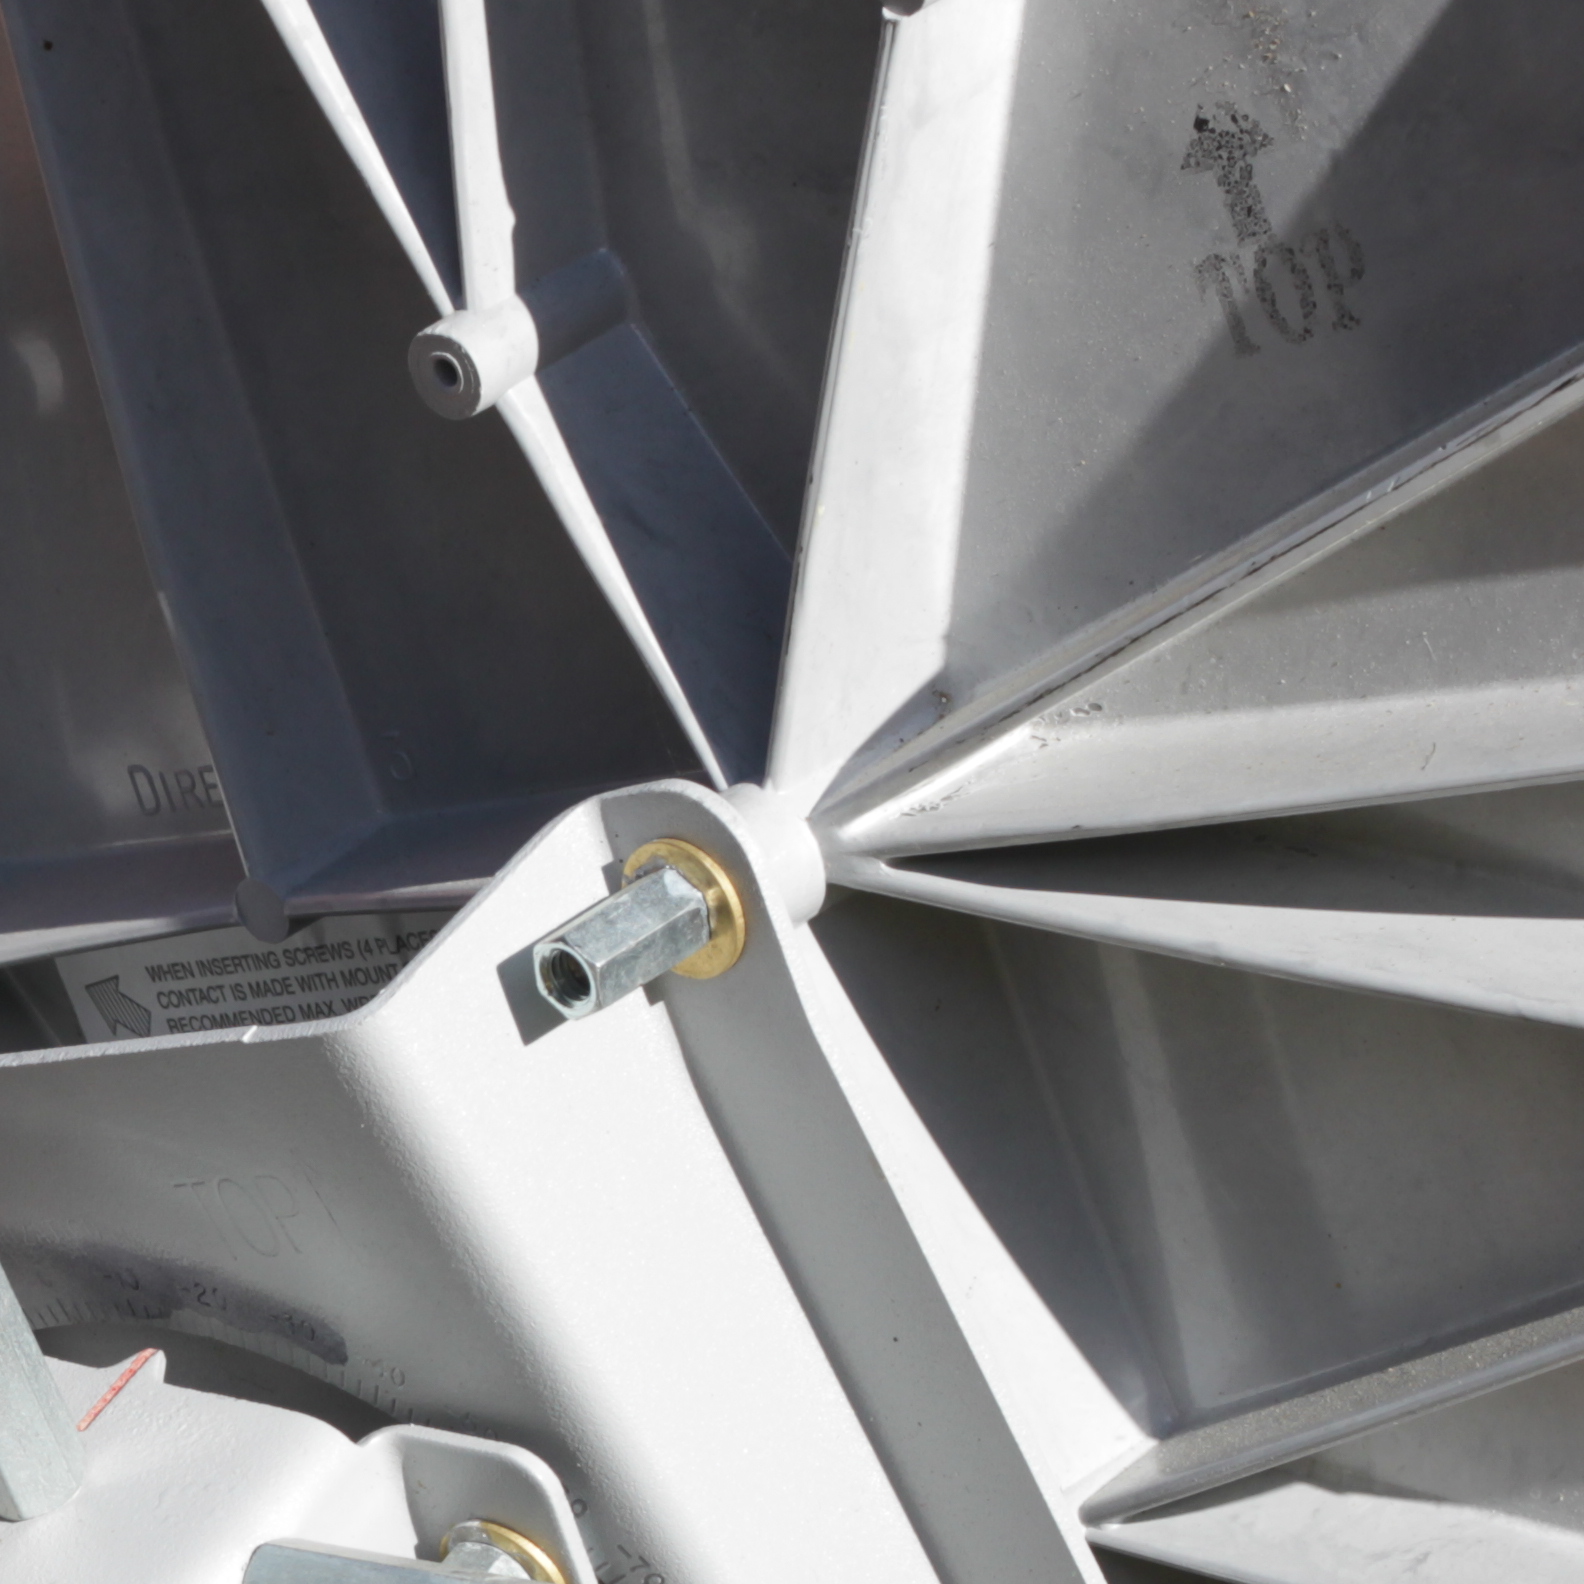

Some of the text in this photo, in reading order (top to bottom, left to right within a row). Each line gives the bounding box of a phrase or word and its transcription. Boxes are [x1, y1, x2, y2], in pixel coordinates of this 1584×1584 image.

[1194, 224, 1365, 356] TOP
[144, 961, 196, 983] WHEN
[195, 950, 282, 978] INSERTING
[282, 940, 356, 967] SCREWS
[358, 938, 375, 962] (4
[157, 961, 400, 1010] CONTACT IS MADE WITH MOUNT
[165, 1004, 297, 1034] RECOMMENDED
[172, 1173, 303, 1261] TOP
